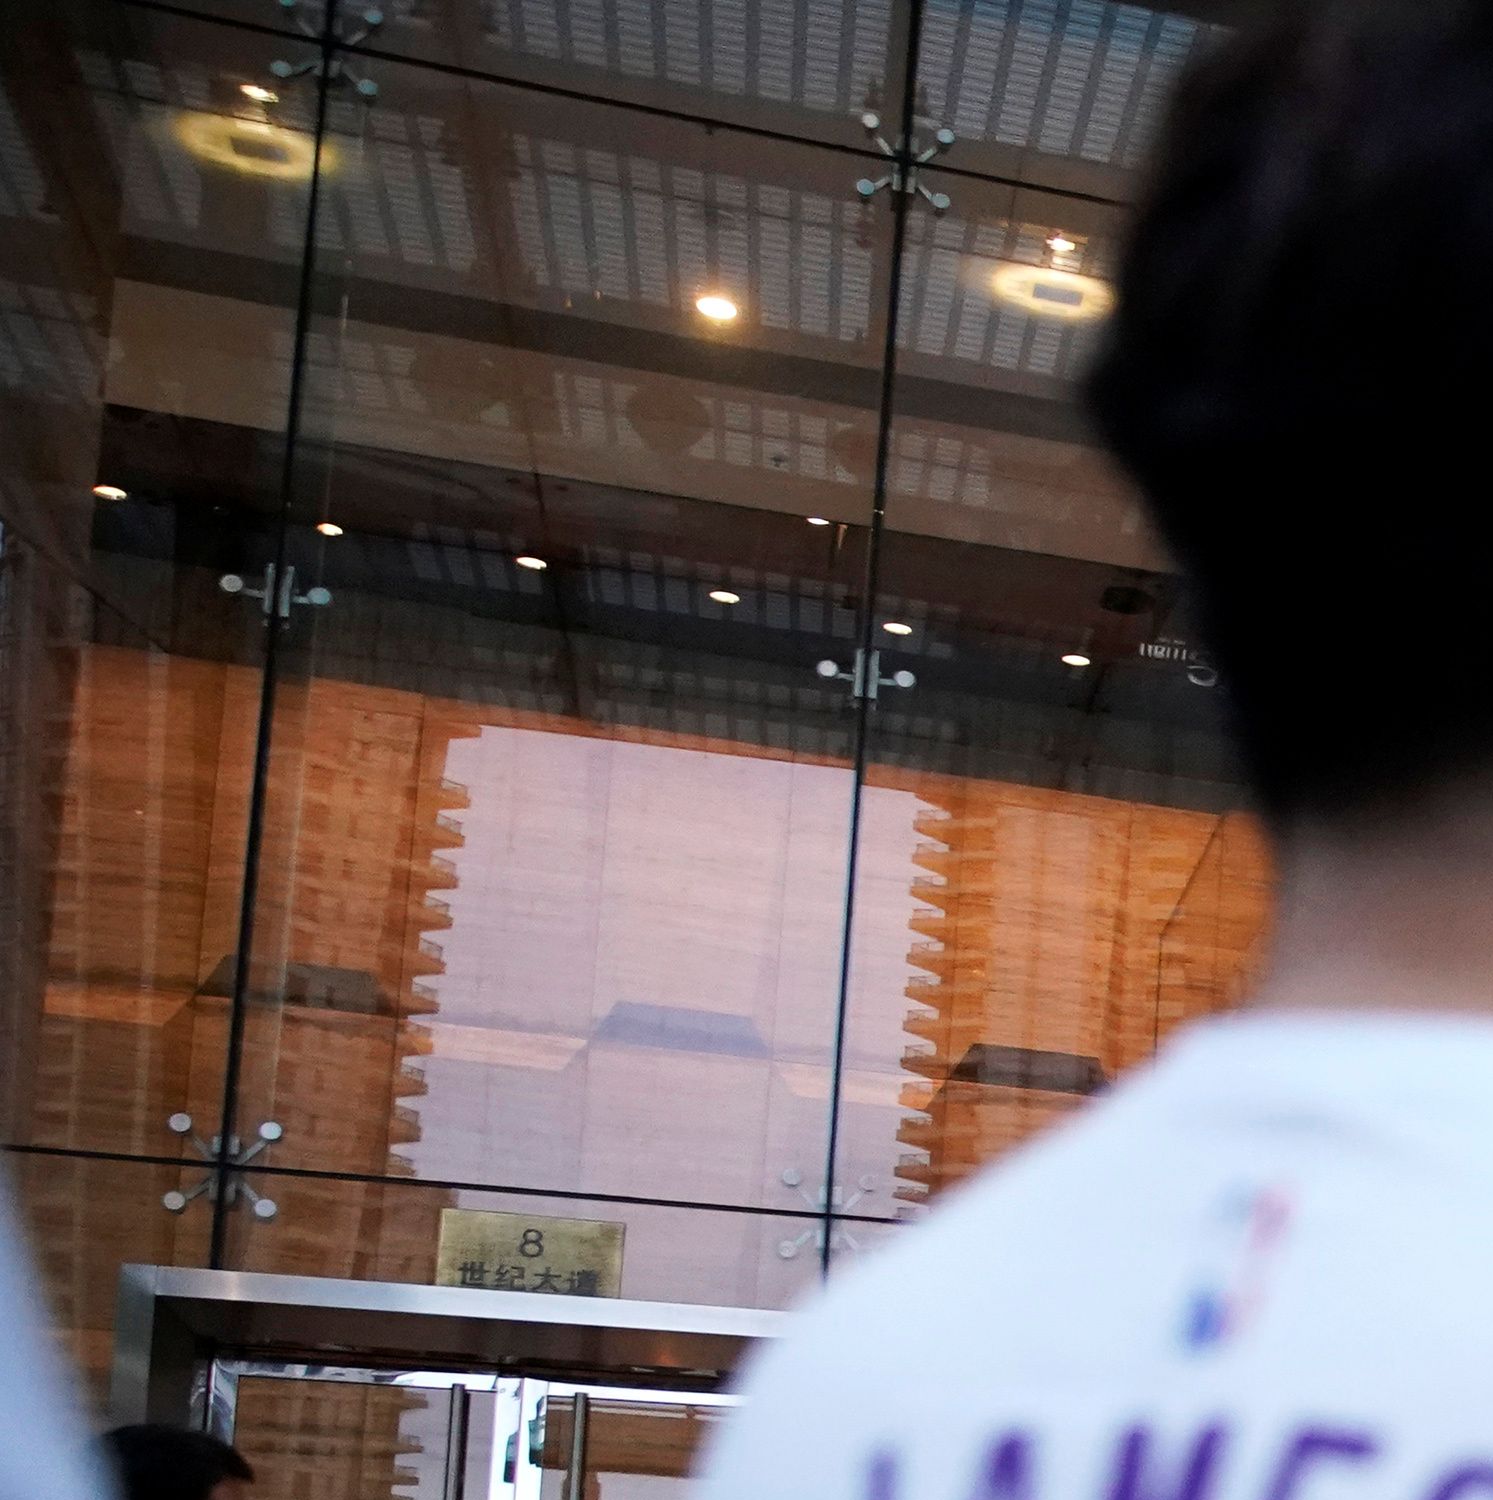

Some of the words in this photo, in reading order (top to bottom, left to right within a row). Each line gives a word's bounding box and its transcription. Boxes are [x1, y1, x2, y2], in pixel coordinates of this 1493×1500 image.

[518, 1228, 545, 1258] 8
[457, 1260, 602, 1296] 世纪大道
